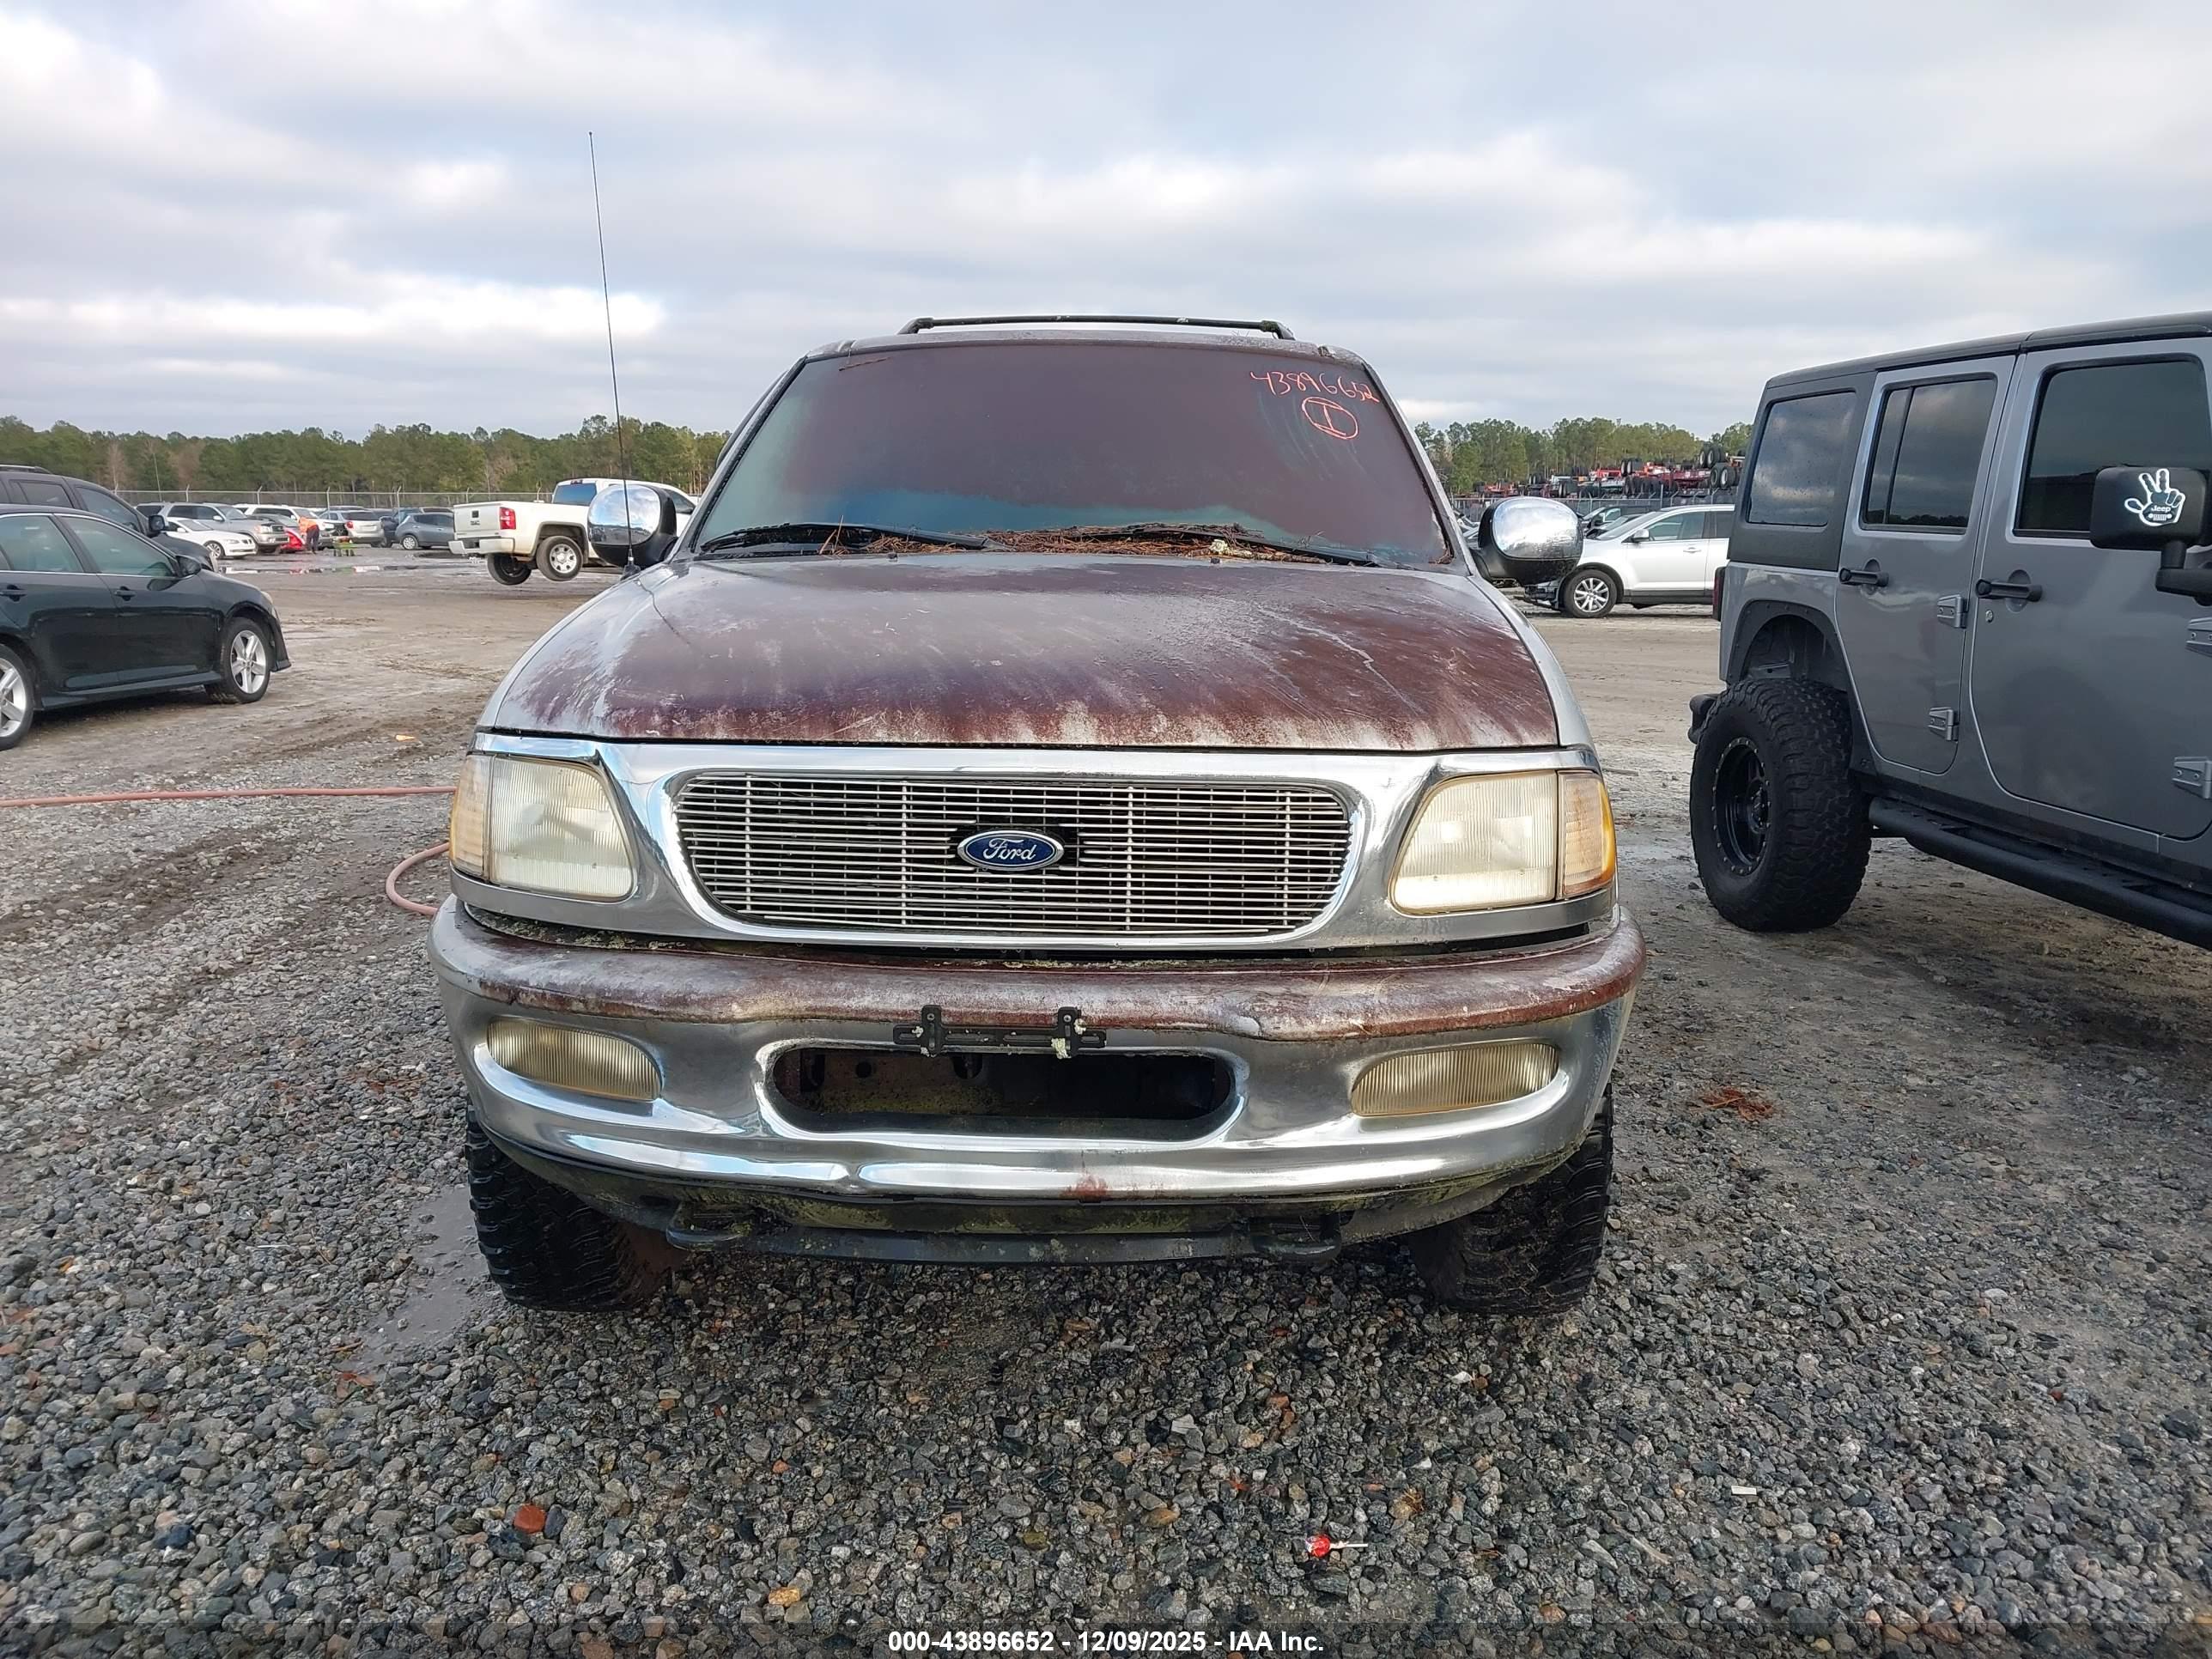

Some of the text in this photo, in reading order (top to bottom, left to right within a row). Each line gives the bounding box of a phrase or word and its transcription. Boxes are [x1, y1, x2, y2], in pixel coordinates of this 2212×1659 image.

[1249, 370, 1380, 403] 43896652
[2150, 505, 2172, 514] Jeep
[982, 837, 1036, 860] Ford
